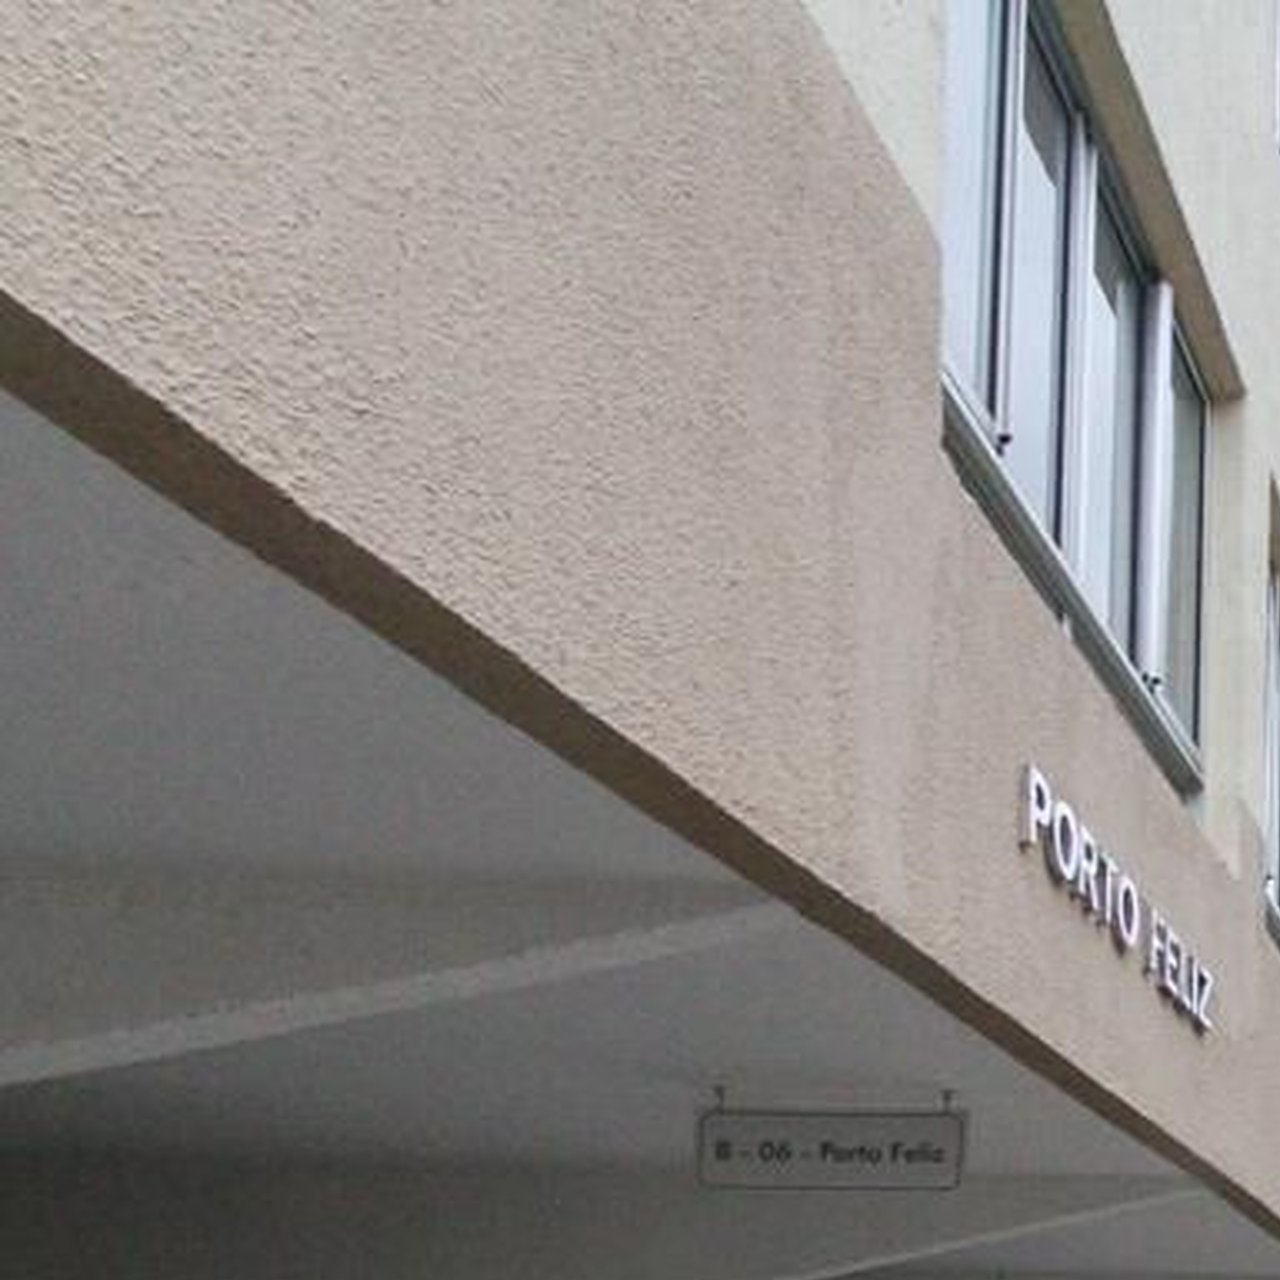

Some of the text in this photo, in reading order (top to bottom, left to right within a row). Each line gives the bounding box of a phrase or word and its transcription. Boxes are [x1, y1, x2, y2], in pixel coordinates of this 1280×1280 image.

[1022, 762, 1213, 1032] PORTO FELIZ
[820, 1140, 882, 1163] Porto
[890, 1140, 944, 1163] Feliz
